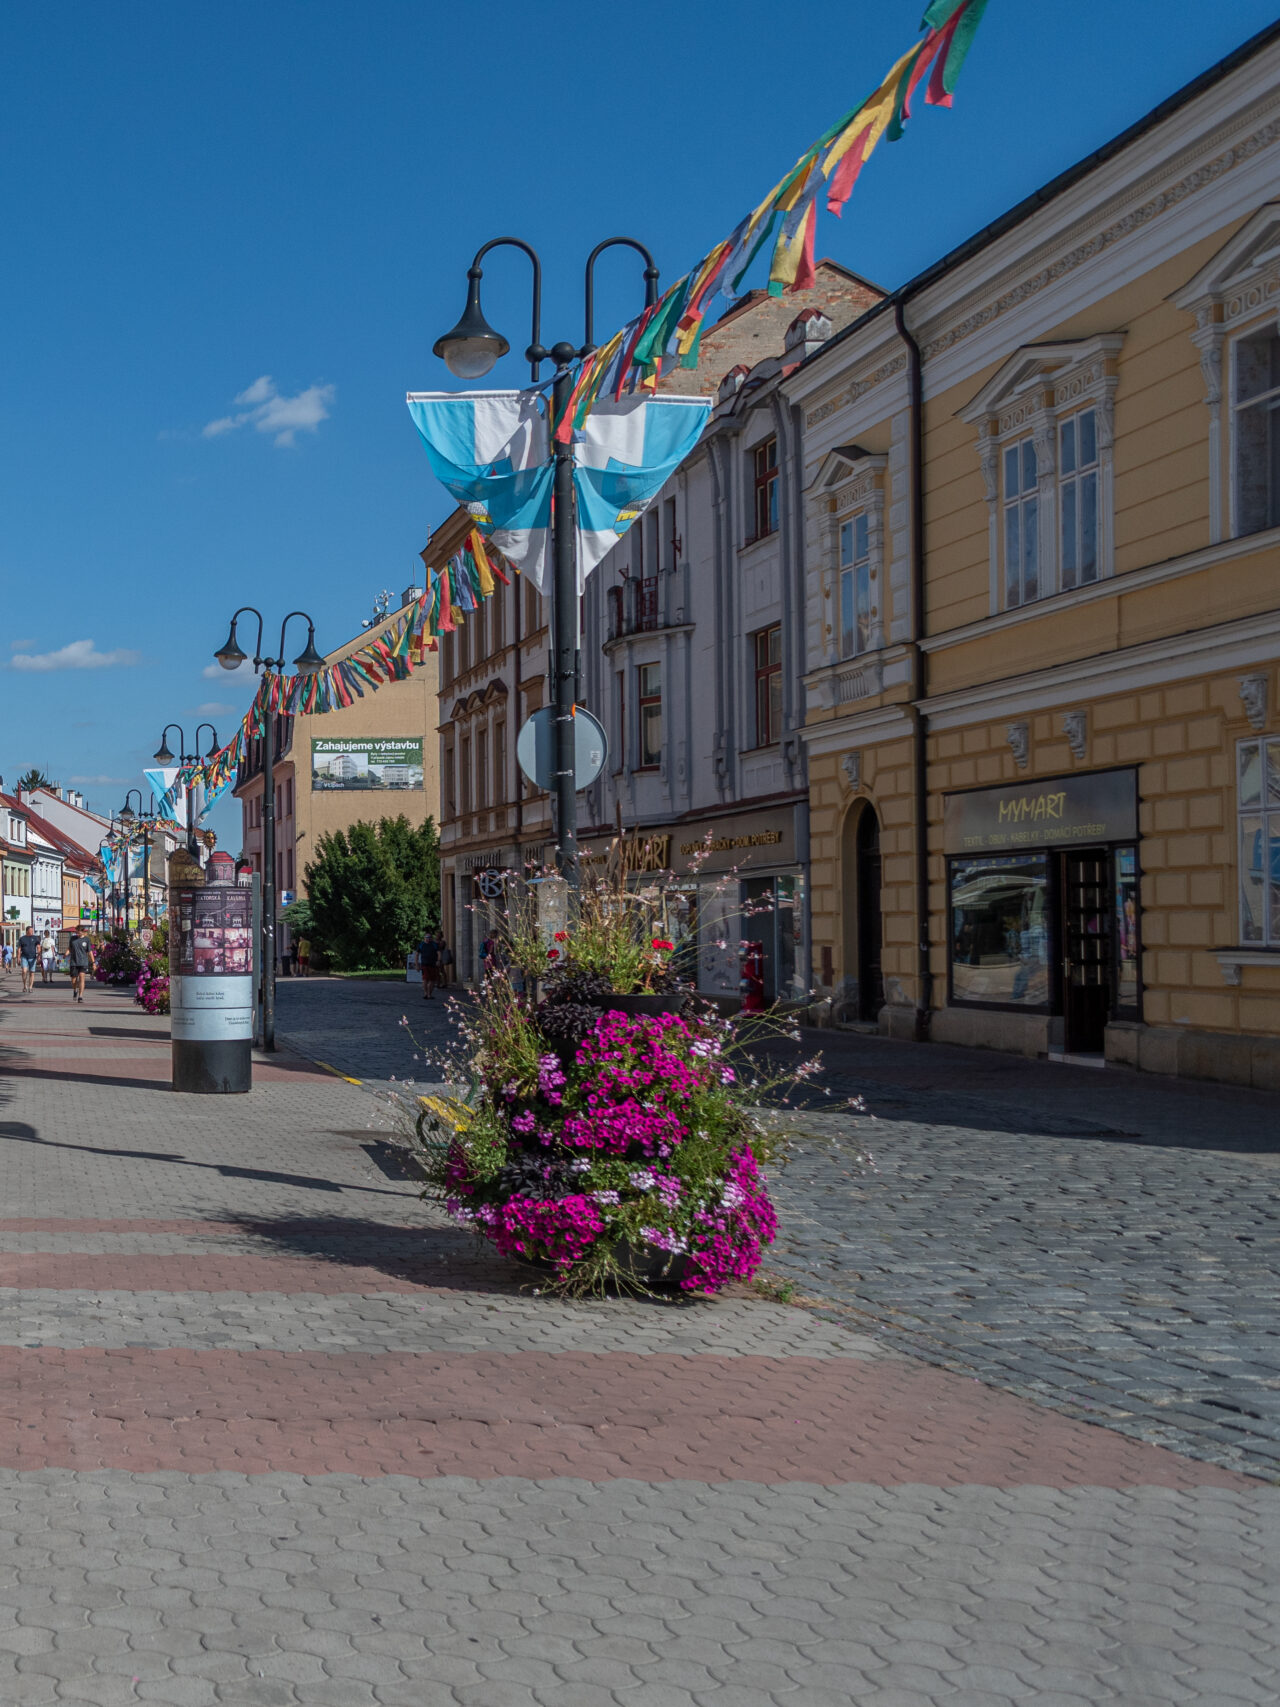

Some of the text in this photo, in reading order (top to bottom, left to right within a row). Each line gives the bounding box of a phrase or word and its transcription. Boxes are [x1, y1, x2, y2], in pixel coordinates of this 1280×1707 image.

[315, 740, 419, 752] Zahajujeme výstavbu
[999, 792, 1067, 823] MYMART
